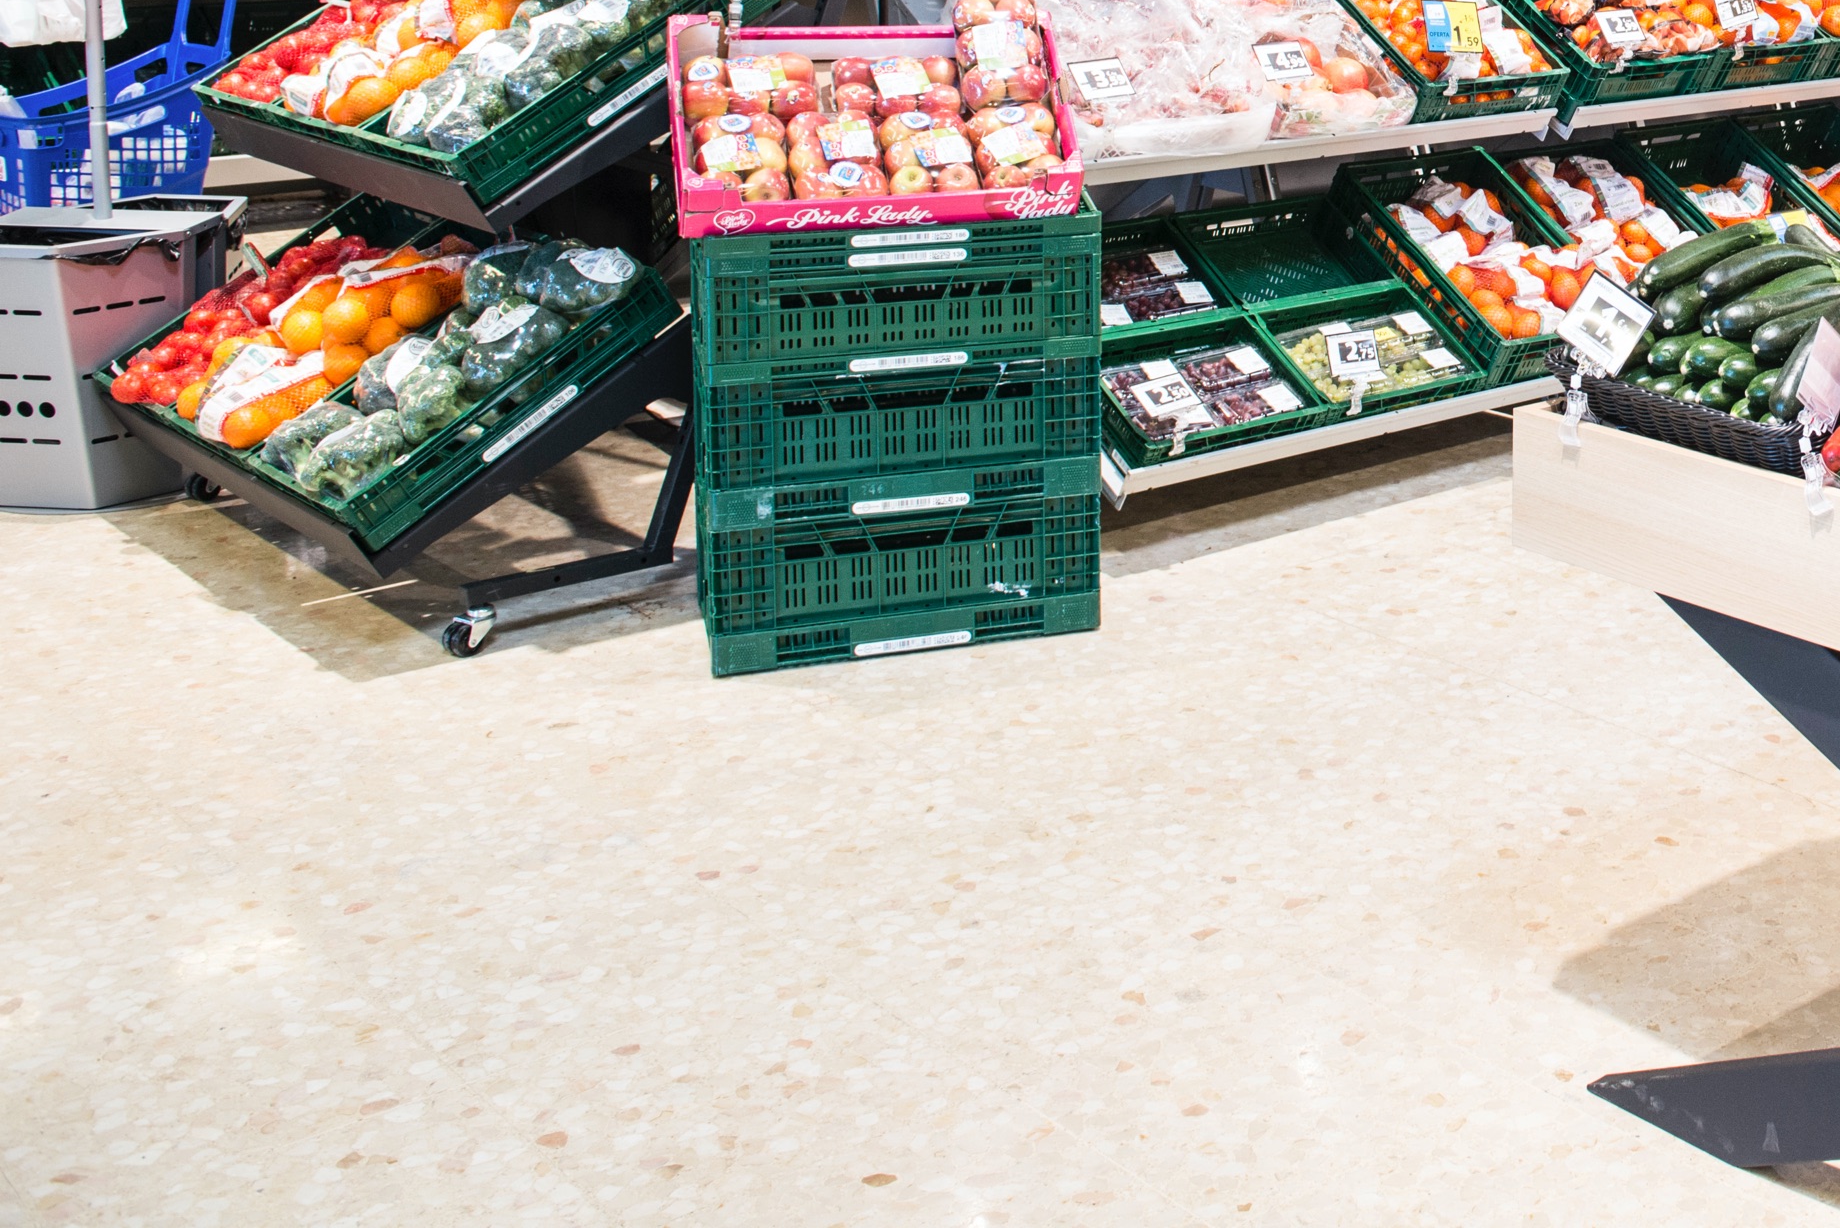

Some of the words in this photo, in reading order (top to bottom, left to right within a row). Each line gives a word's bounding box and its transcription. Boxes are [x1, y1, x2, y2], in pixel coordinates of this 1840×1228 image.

[1453, 25, 1479, 48] 1,59
[1005, 180, 1074, 211] Pink
[766, 208, 861, 229] Pink
[861, 205, 938, 225] Lady
[1015, 200, 1076, 220] Lady
[1345, 341, 1375, 363] 2,75
[1152, 385, 1191, 404] 2,50
